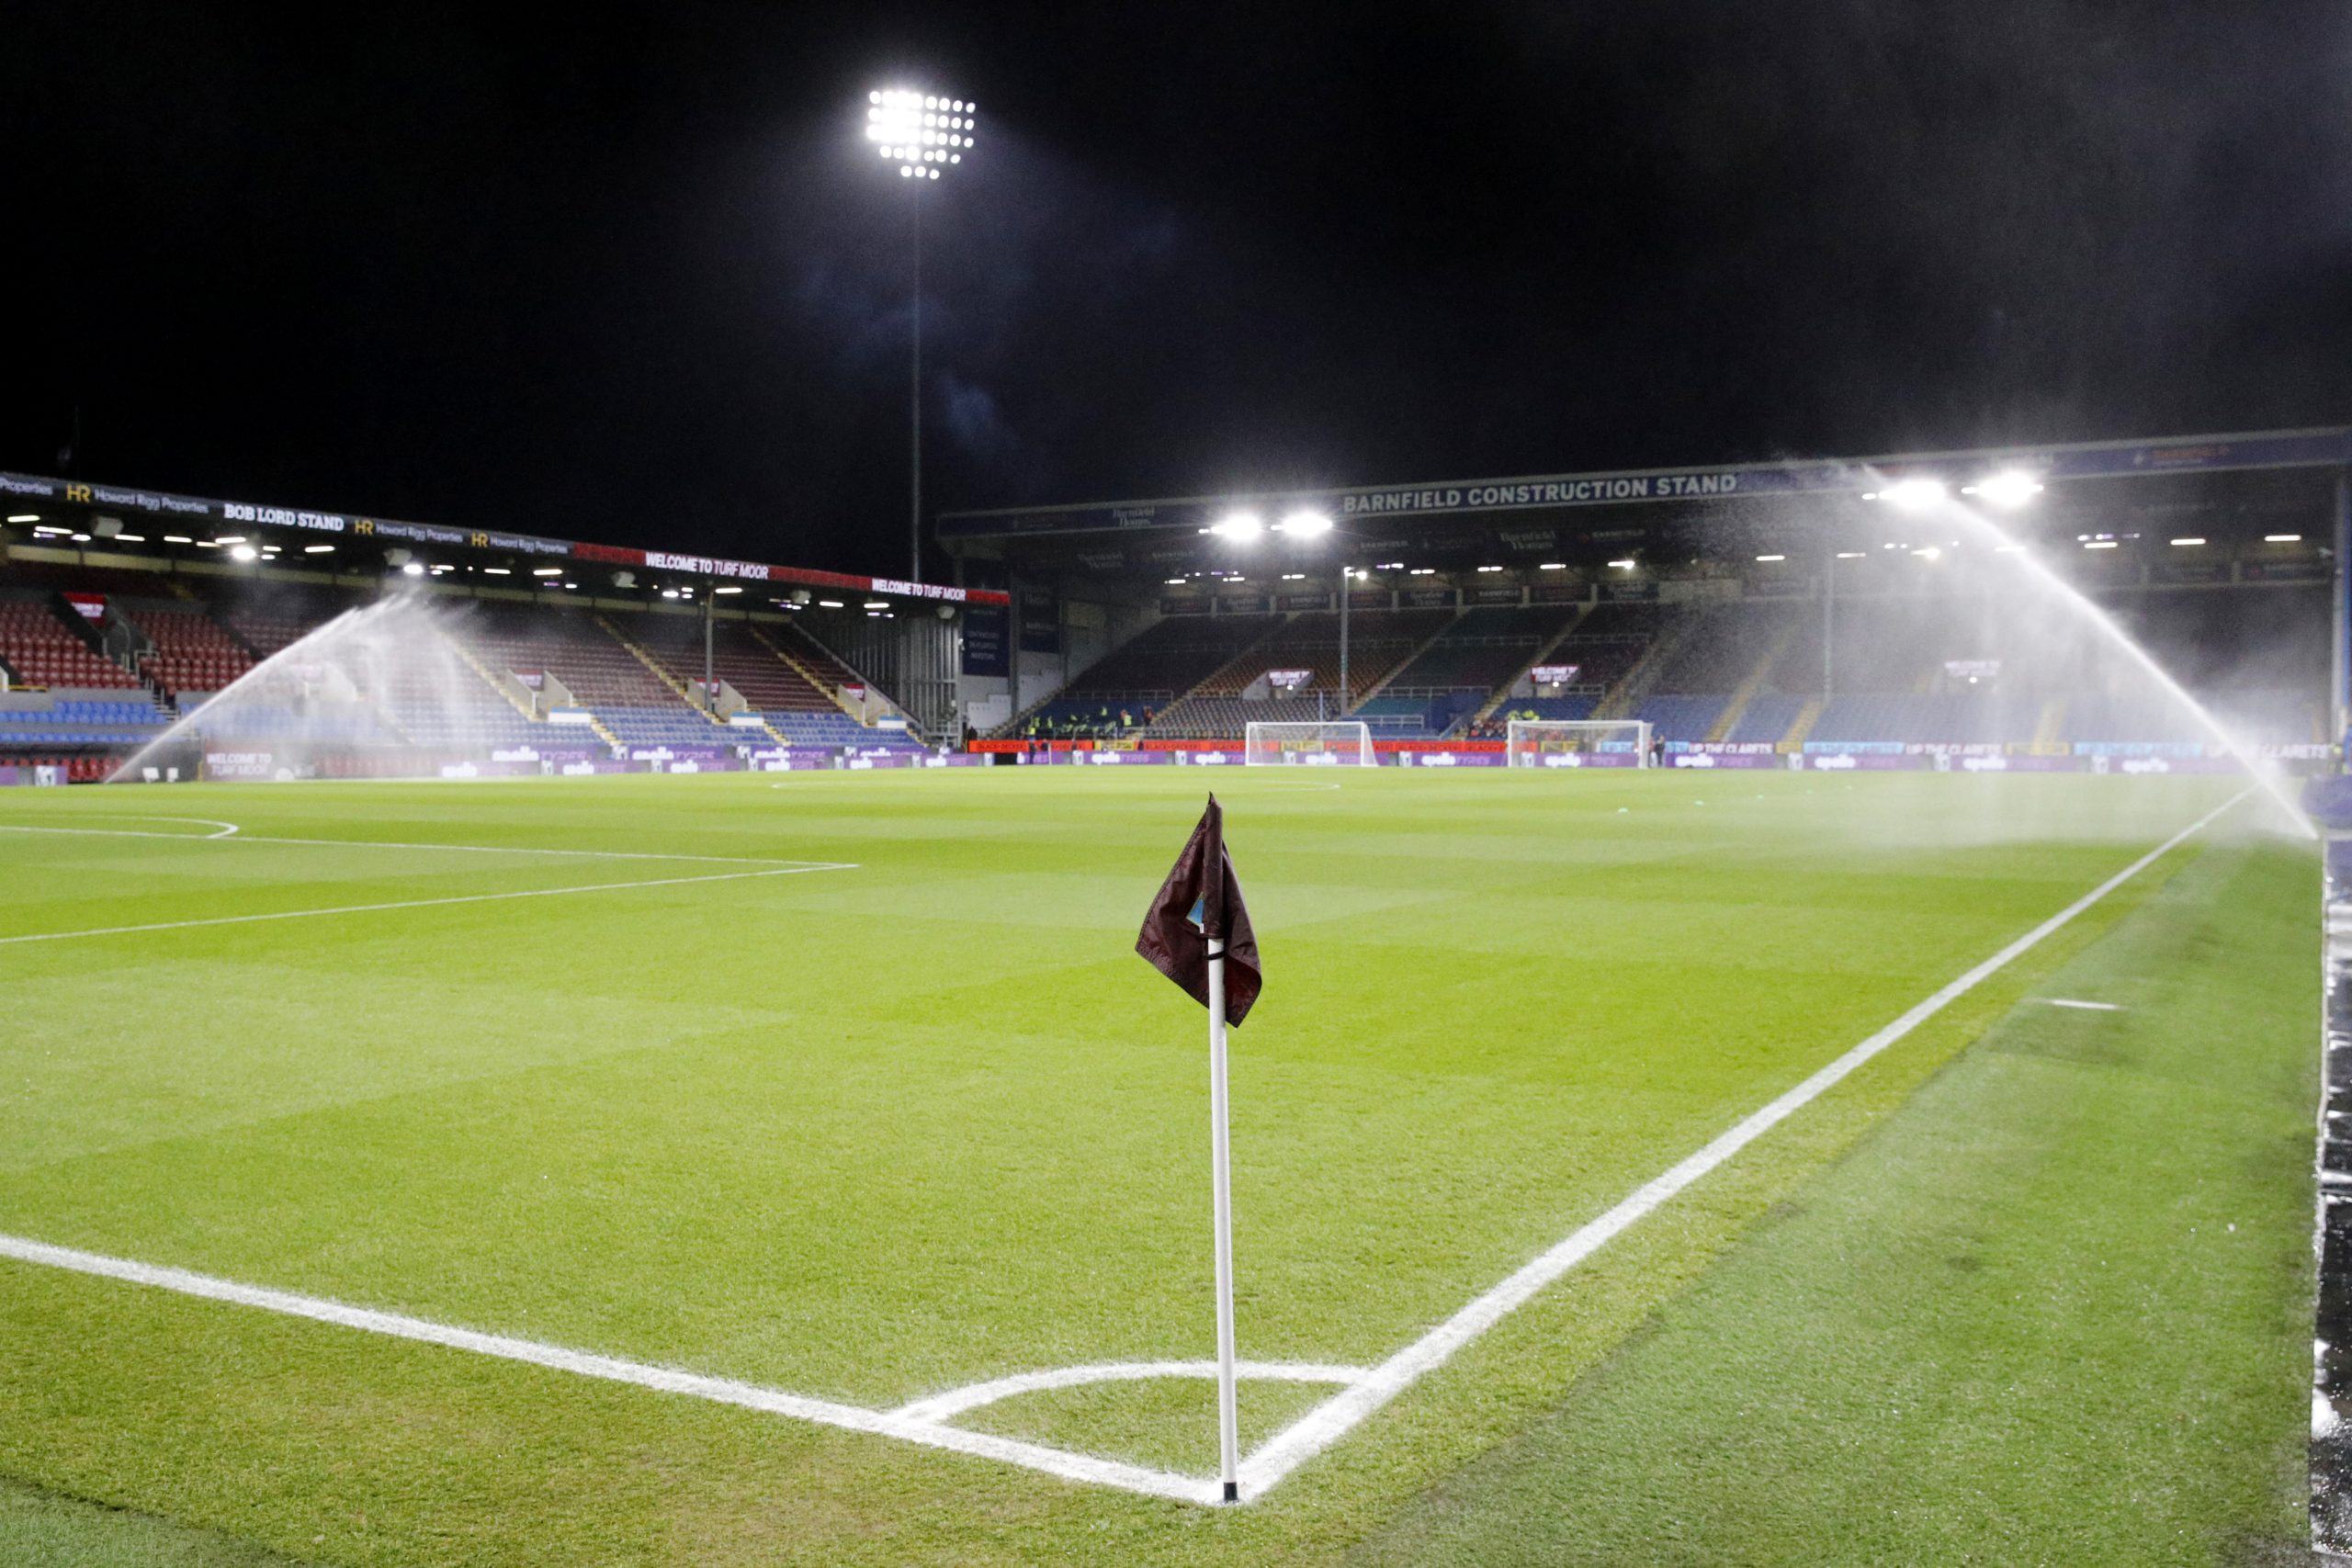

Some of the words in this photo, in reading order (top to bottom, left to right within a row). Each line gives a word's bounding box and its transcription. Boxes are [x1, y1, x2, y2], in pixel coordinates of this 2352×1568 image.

[66, 484, 91, 503] HR
[95, 489, 135, 505] Howard
[161, 496, 209, 514] Properties
[1344, 489, 1461, 513] BARNFIELD
[1467, 478, 1648, 505] CONSTRUCTION
[1657, 474, 1737, 495] STAND
[224, 503, 255, 521] BOB
[256, 507, 296, 526] LORD
[297, 513, 345, 532] STAND
[355, 519, 374, 536] HR
[471, 533, 490, 548] HR
[645, 551, 698, 572] WELCOME
[698, 558, 713, 574] TO
[713, 559, 739, 578] TURF
[738, 563, 770, 580] MOOR
[872, 578, 912, 597] WELCOME
[912, 582, 923, 597] TO
[923, 584, 943, 599] TURF
[943, 587, 966, 602] MOOR
[207, 753, 255, 764] WELCOME
[257, 753, 272, 764] TO
